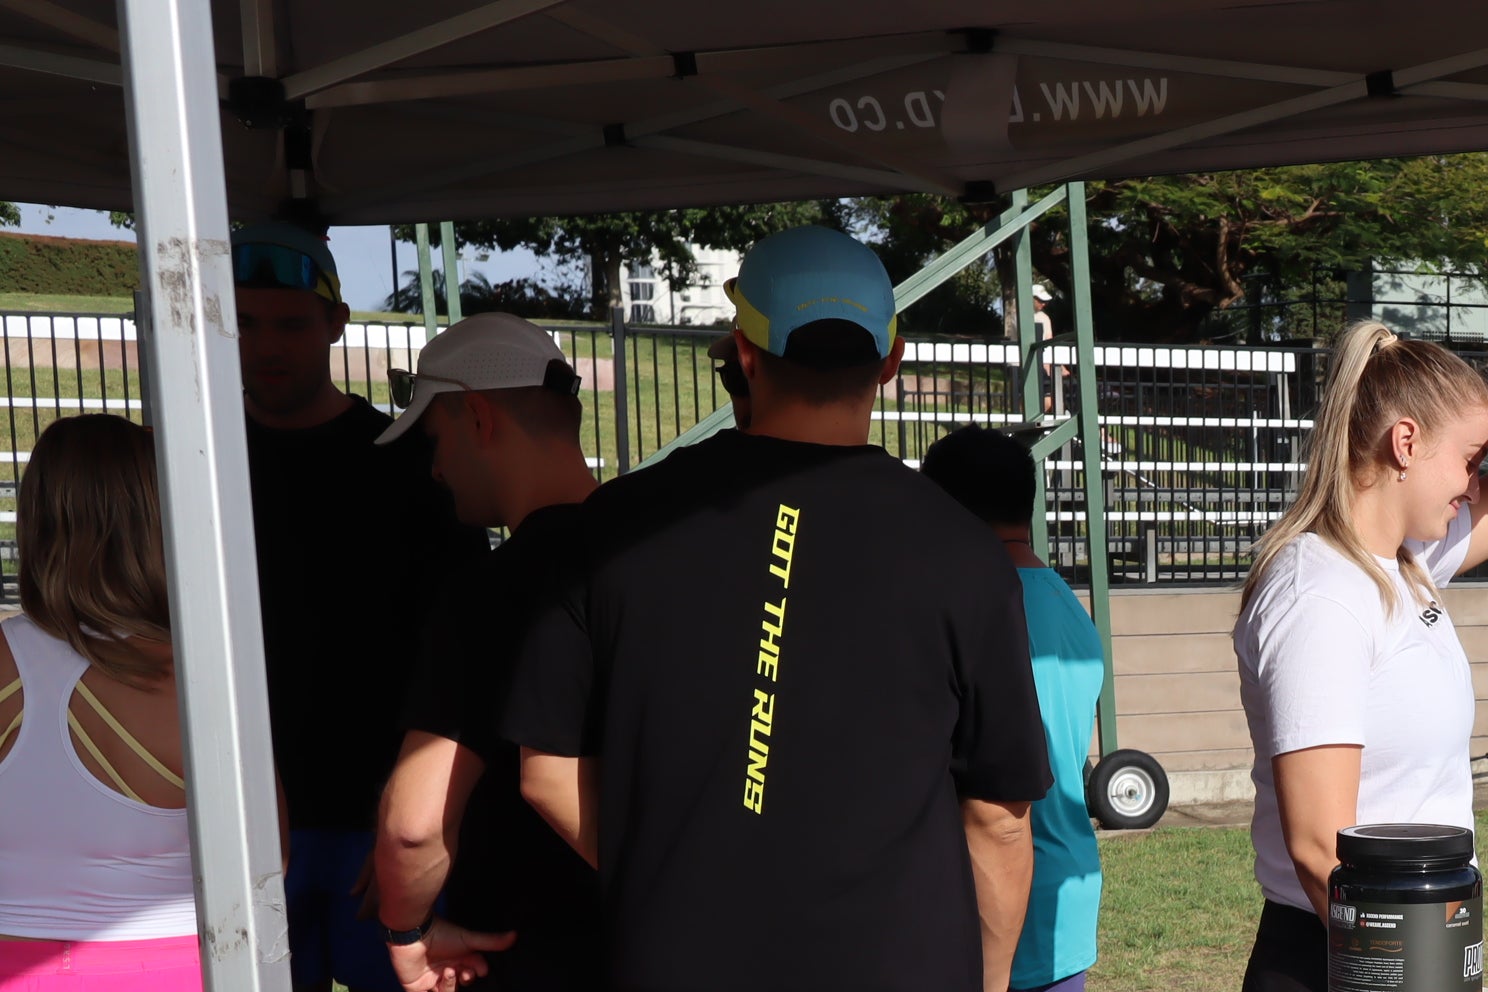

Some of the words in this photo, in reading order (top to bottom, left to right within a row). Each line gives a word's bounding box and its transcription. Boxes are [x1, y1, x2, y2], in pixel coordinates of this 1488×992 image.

[769, 503, 800, 589] GOT
[757, 597, 787, 682] THE
[743, 688, 775, 815] RUNS
